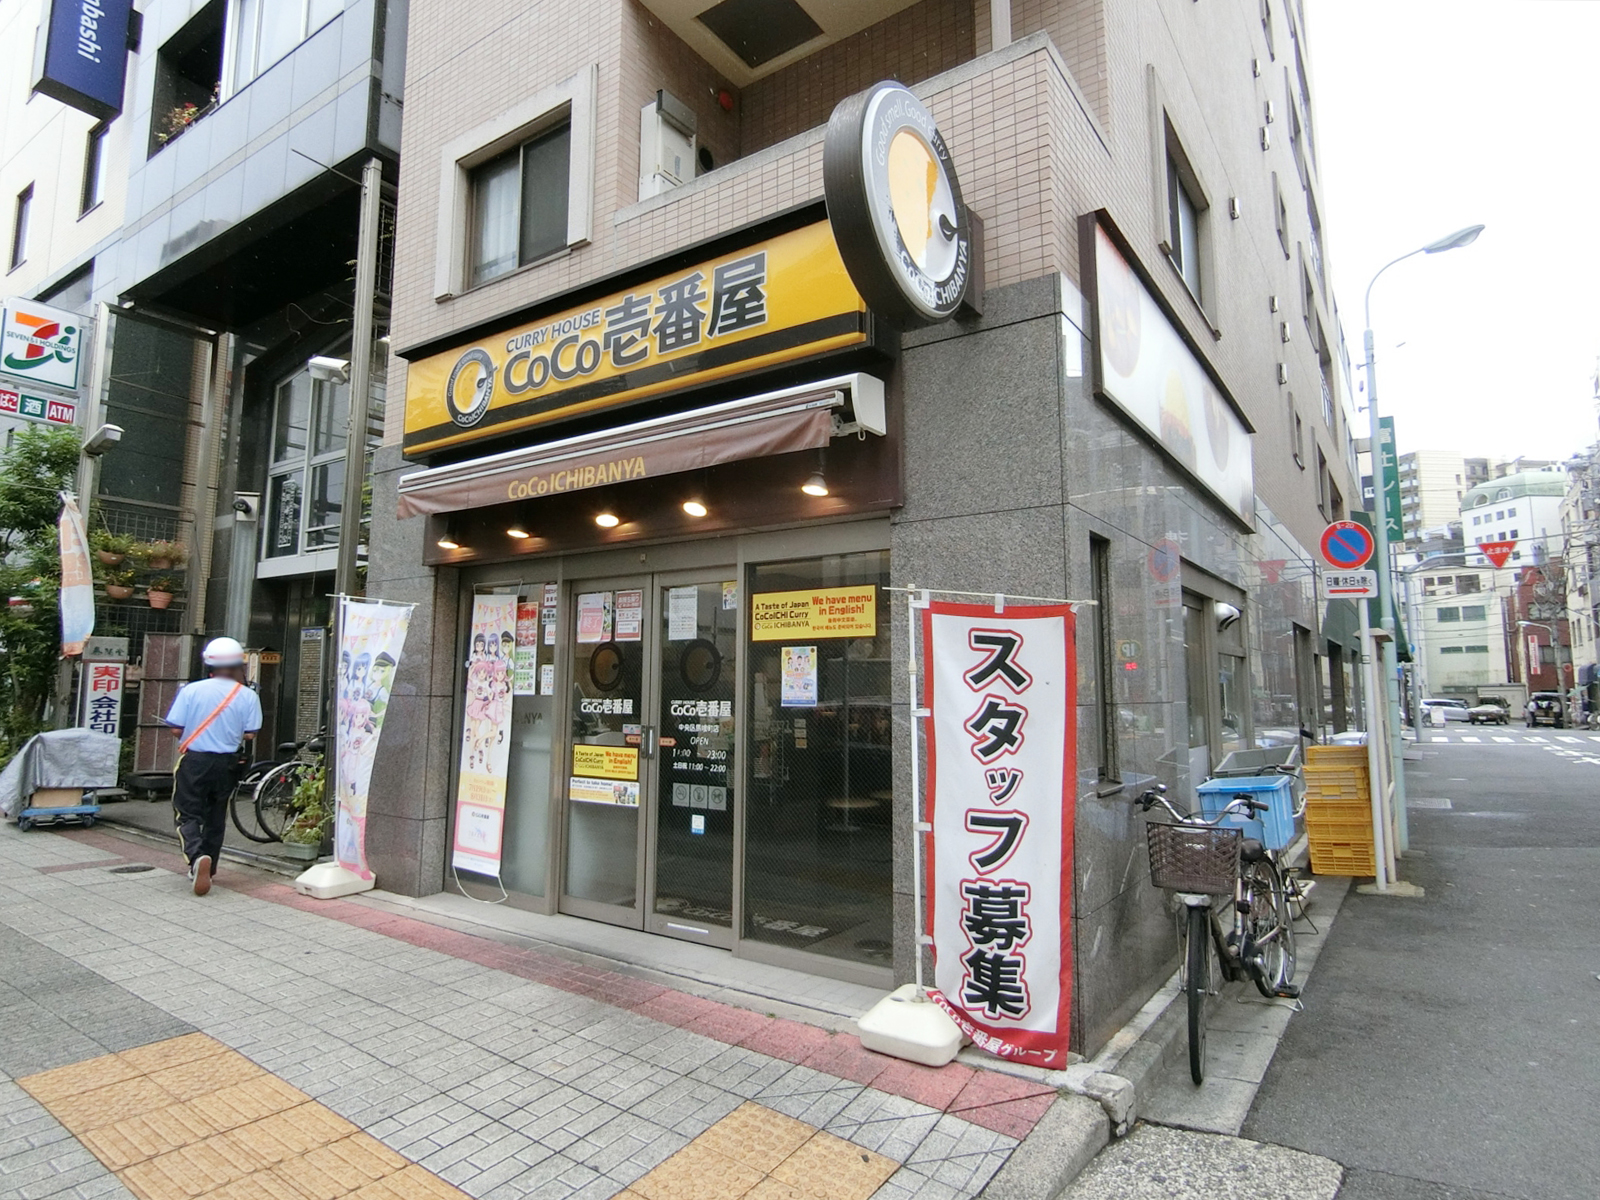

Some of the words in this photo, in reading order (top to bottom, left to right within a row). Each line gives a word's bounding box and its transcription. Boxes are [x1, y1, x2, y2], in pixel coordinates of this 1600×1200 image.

[876, 116, 889, 166] Good
[904, 100, 927, 128] Good
[506, 324, 550, 353] CURRY
[551, 308, 601, 336] HOUSE
[39, 340, 76, 353] HOLDINGS
[24, 398, 43, 415] 酒
[49, 405, 73, 422] ATM
[1487, 546, 1510, 555] 止まれ
[789, 600, 810, 609] Japan
[812, 596, 824, 605] We
[826, 595, 846, 604] have
[848, 594, 872, 603] menu
[789, 610, 809, 619] Curry
[819, 607, 827, 615] in
[828, 604, 865, 615] English!
[774, 620, 810, 629] ICHIBANYA
[690, 736, 709, 745] OPEN
[707, 750, 727, 760] 23:00
[688, 762, 703, 771] 11:00
[710, 764, 727, 772] 22:00
[963, 631, 1030, 1017] スタッフ募集
